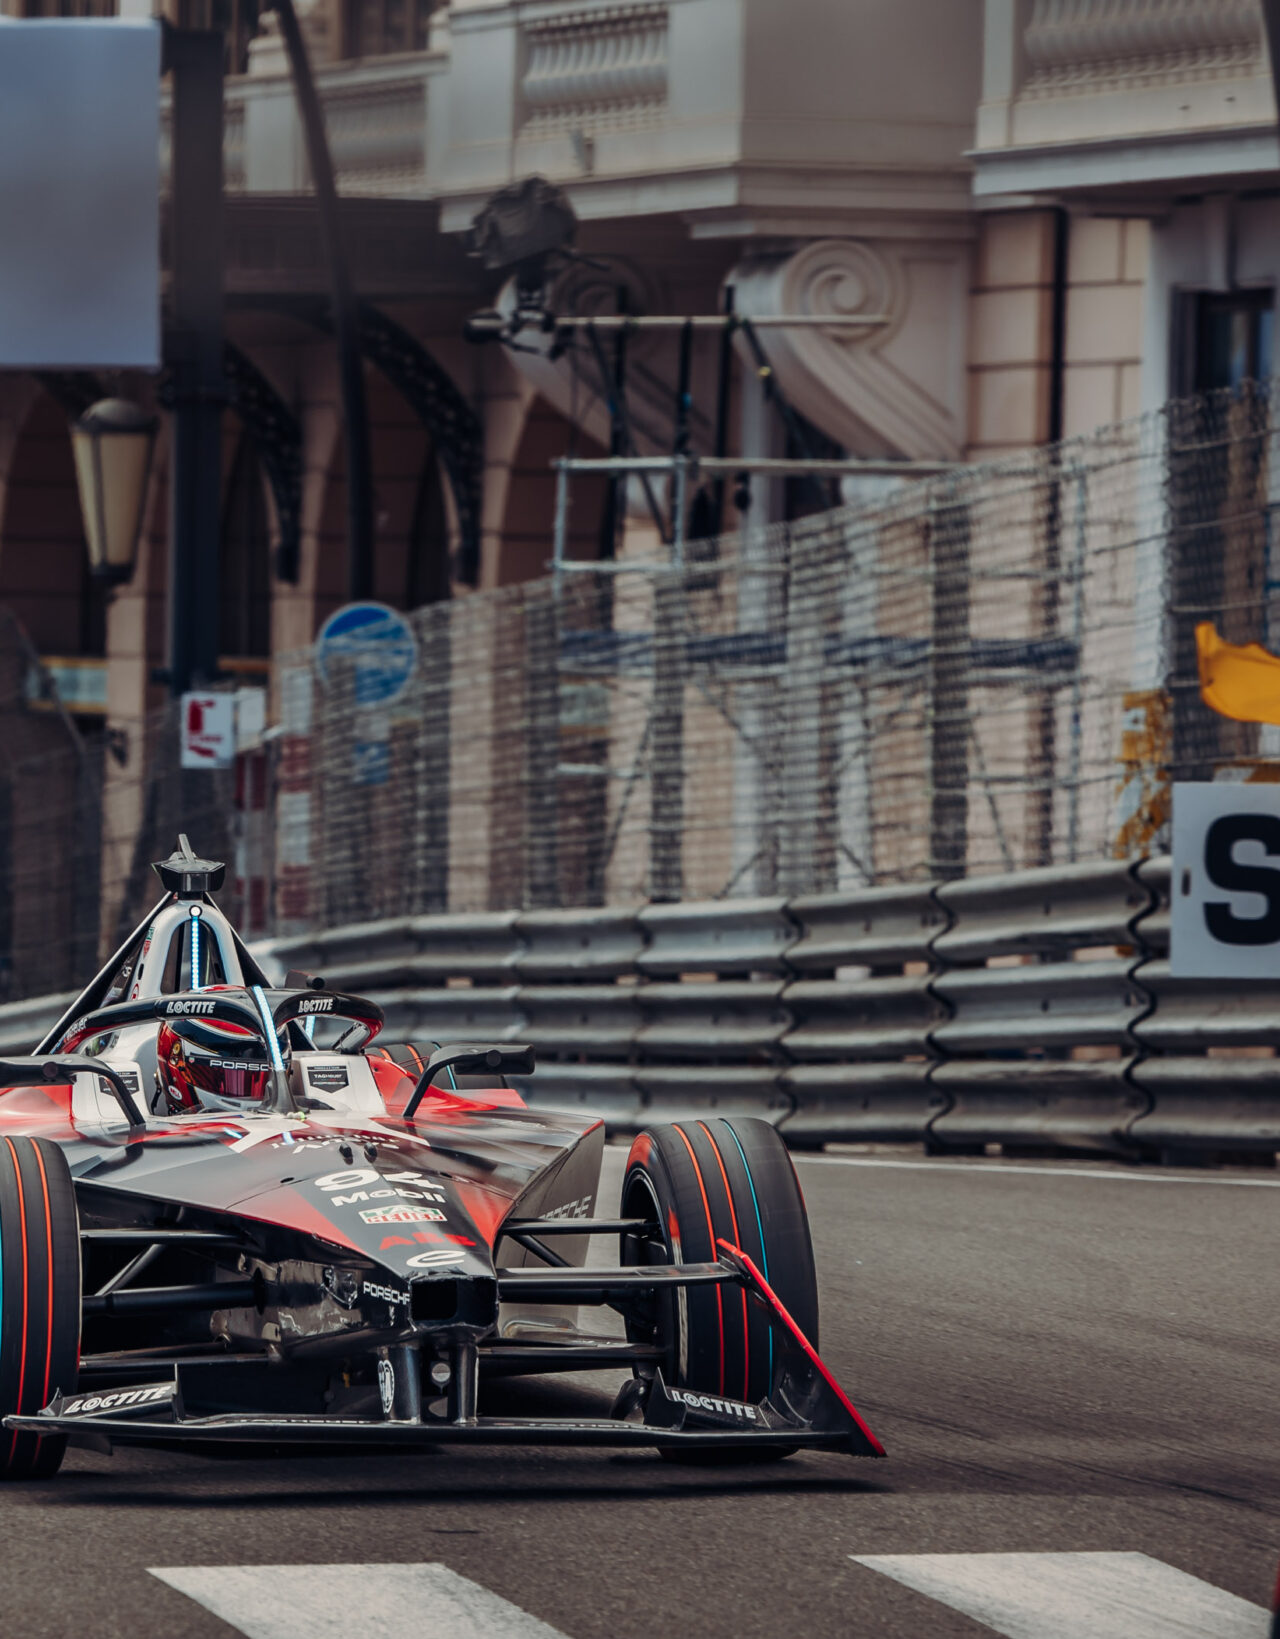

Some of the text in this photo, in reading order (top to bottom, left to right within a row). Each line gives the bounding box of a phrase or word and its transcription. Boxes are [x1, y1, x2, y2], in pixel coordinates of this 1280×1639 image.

[1203, 813, 1280, 946] S
[166, 1001, 216, 1014] LOCTITE
[298, 999, 334, 1013] LOCTITE
[209, 1059, 272, 1072] PORSC
[314, 1169, 446, 1192] 94
[330, 1188, 446, 1207] Mobil
[63, 1385, 171, 1415] LOCTITE
[671, 1389, 757, 1419] LOCTITE
